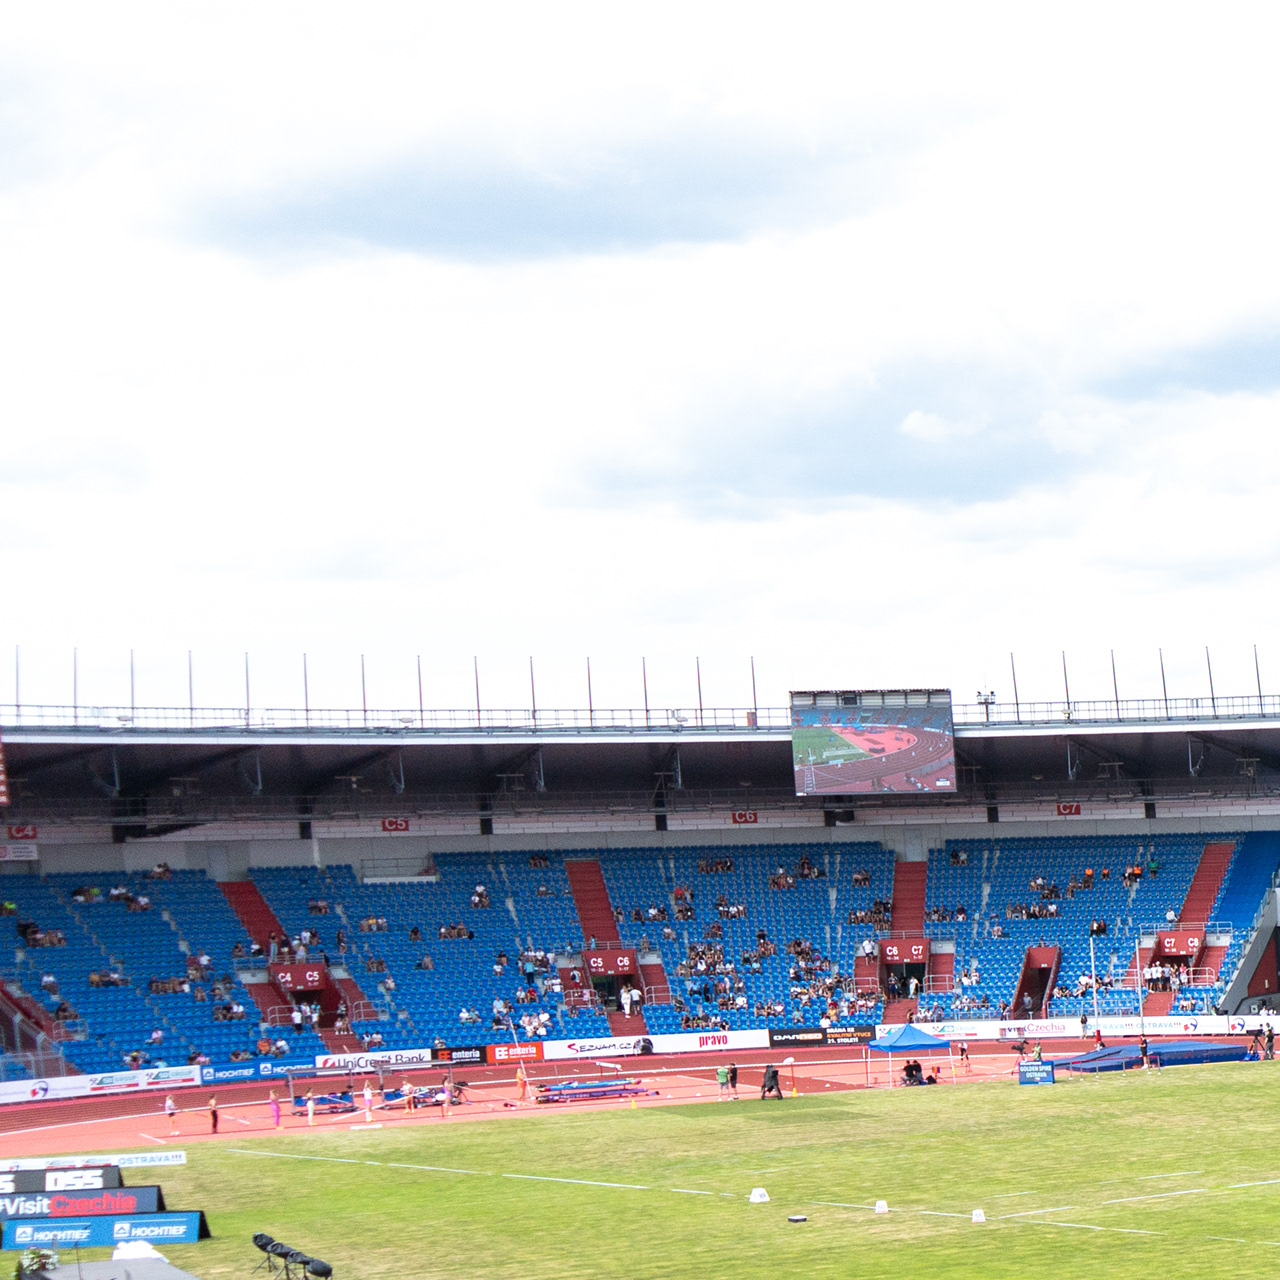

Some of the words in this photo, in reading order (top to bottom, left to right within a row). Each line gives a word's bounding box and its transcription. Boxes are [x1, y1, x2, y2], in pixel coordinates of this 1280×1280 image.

[1060, 804, 1077, 814] C7
[735, 811, 755, 822] C6
[386, 819, 406, 831] C5
[12, 826, 33, 838] C4
[699, 1034, 728, 1048] pravo
[215, 1067, 255, 1080] HOCHTIEF
[131, 1225, 188, 1238] HOCHTIEF
